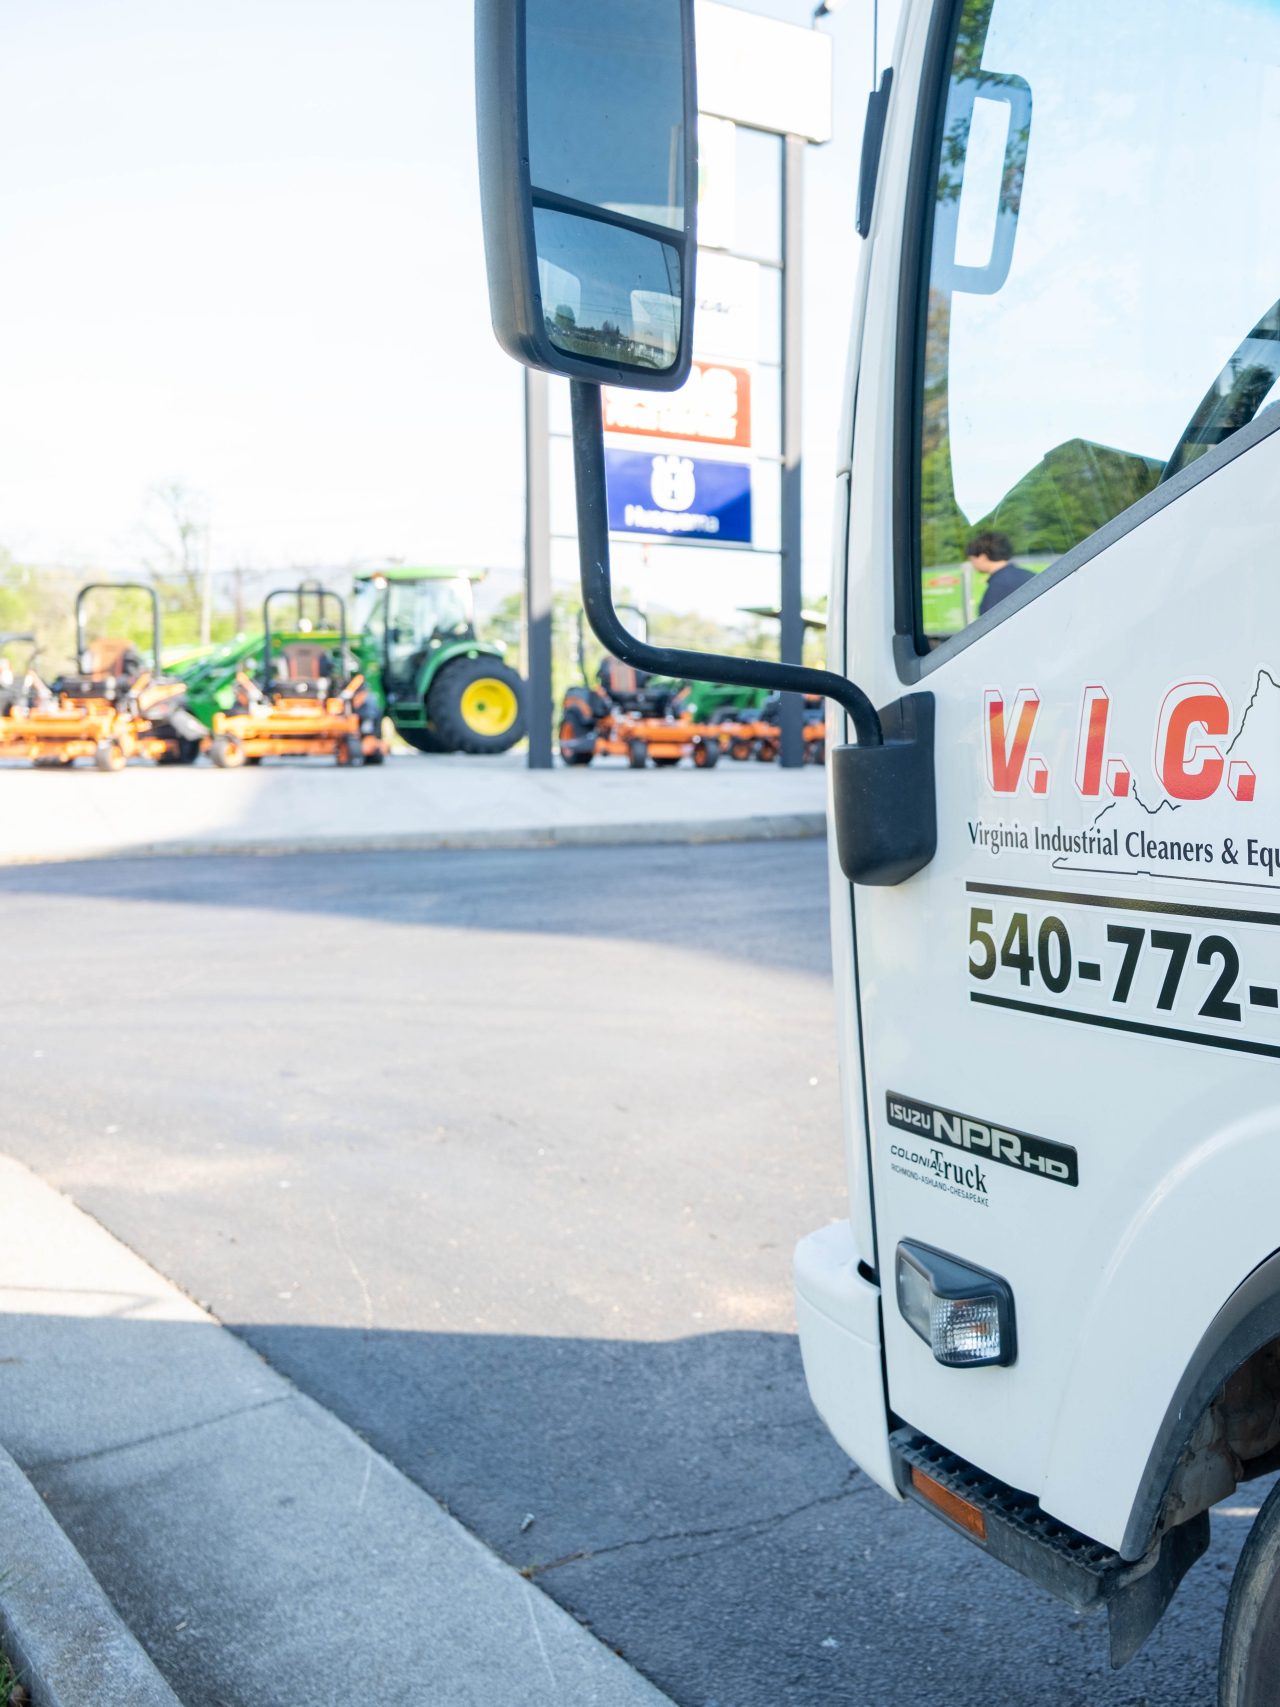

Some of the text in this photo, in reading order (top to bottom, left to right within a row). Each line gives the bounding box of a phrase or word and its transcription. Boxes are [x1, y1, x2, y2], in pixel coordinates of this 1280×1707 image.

[968, 821, 1029, 855] Virginia
[1035, 825, 1119, 856] Industrial
[1125, 829, 1214, 863] Cleaners
[1221, 837, 1239, 865] &
[890, 1102, 1070, 1180] ISUZU NPR HD
[890, 1144, 989, 1194] COLONIAL Truck
